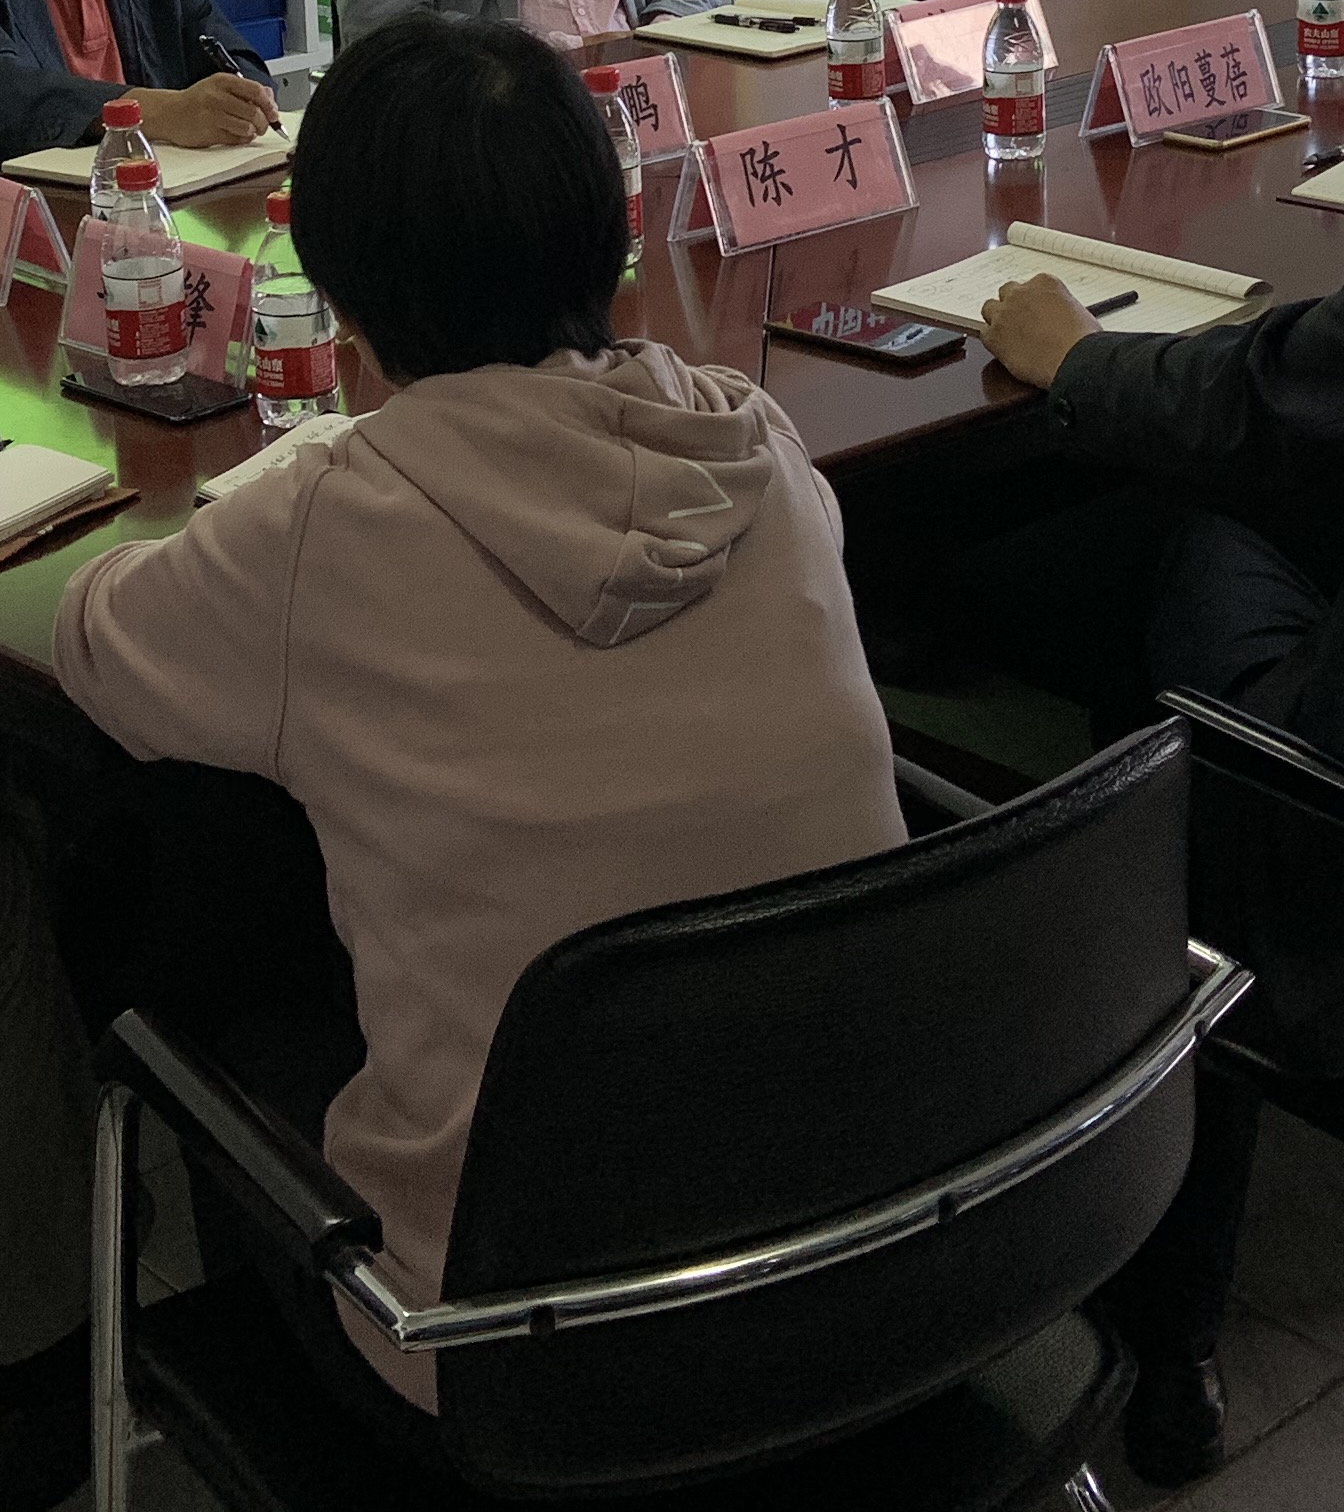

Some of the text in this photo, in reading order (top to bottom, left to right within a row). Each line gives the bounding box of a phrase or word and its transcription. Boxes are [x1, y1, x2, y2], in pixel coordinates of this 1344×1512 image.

[1138, 41, 1250, 118] 欧阳蔓蓓
[739, 122, 863, 208] 陈才
